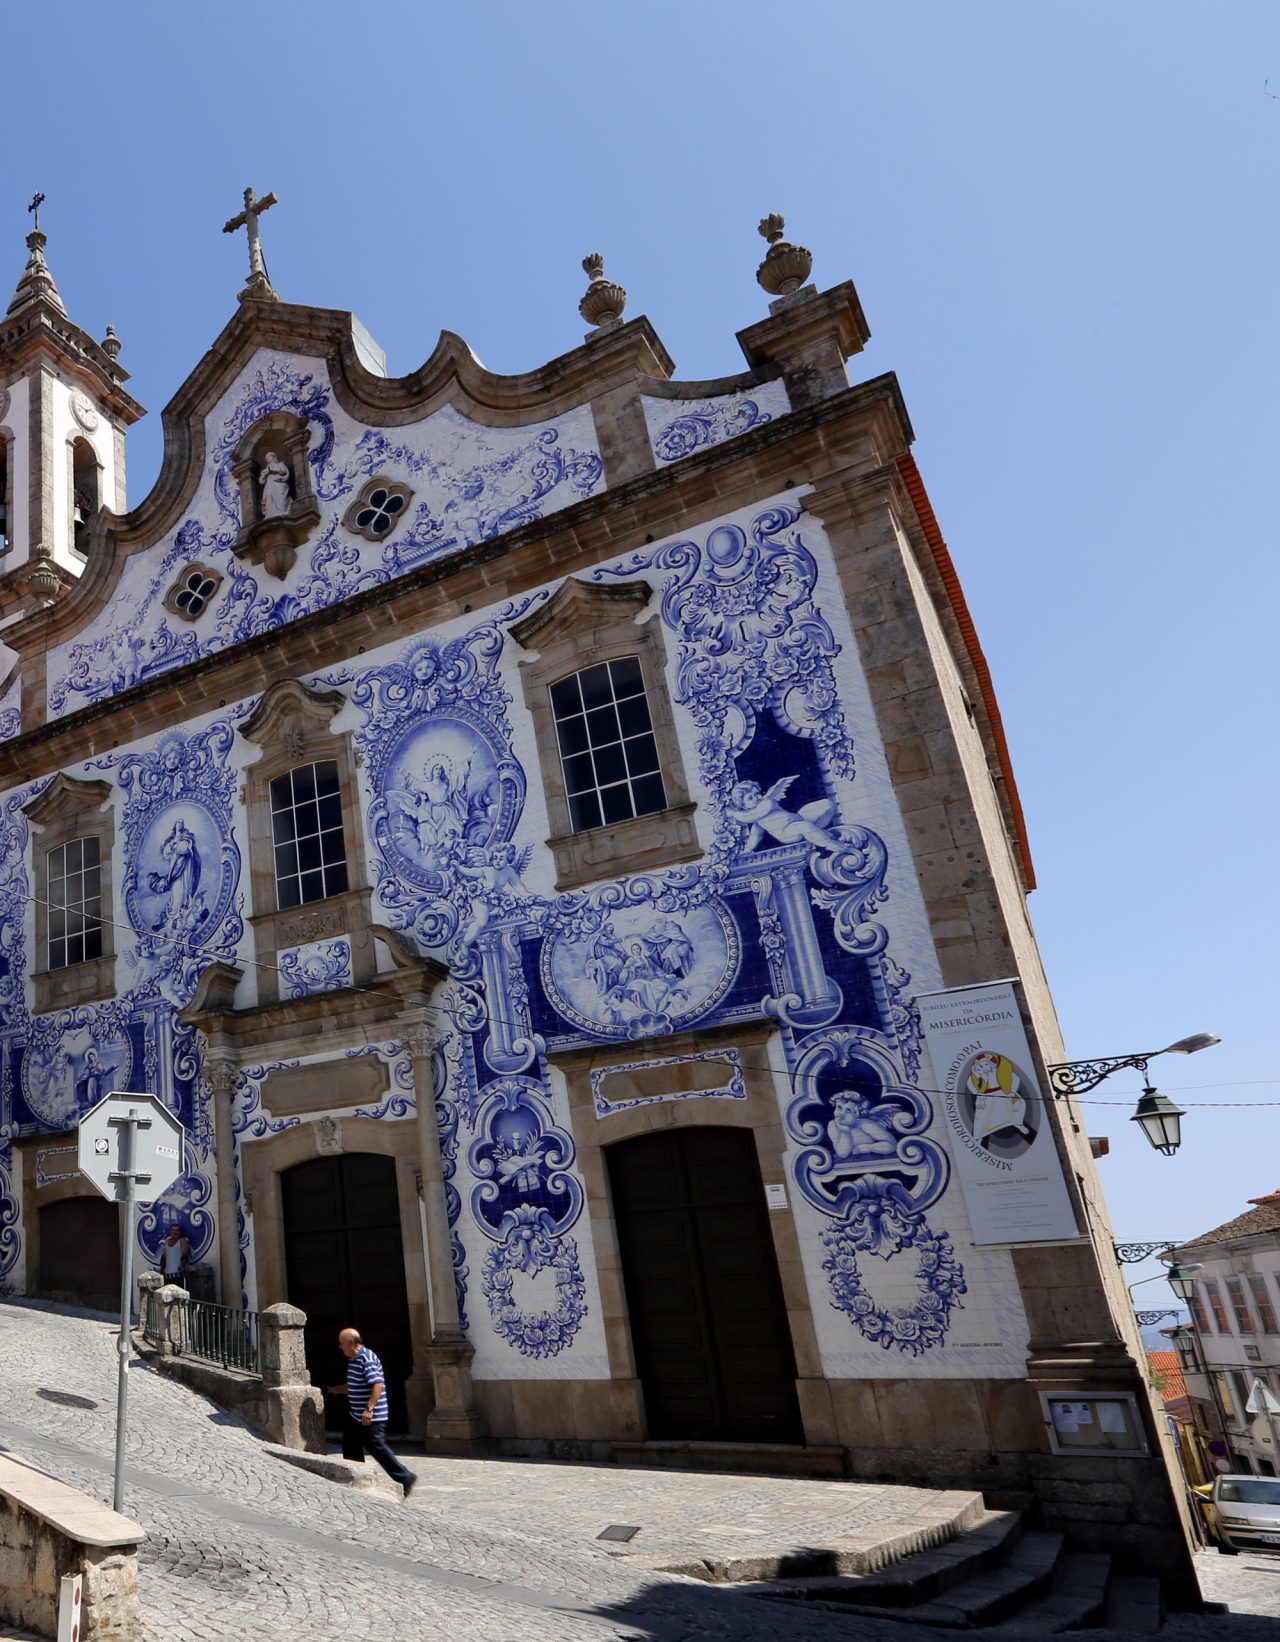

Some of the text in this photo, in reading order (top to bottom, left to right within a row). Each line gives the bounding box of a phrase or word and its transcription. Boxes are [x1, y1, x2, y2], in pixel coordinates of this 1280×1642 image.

[956, 1053, 966, 1062] O
[963, 1040, 982, 1056] PAI
[945, 1061, 961, 1091] COMO
[945, 1092, 1013, 1171] MISERICORDIOSOS
